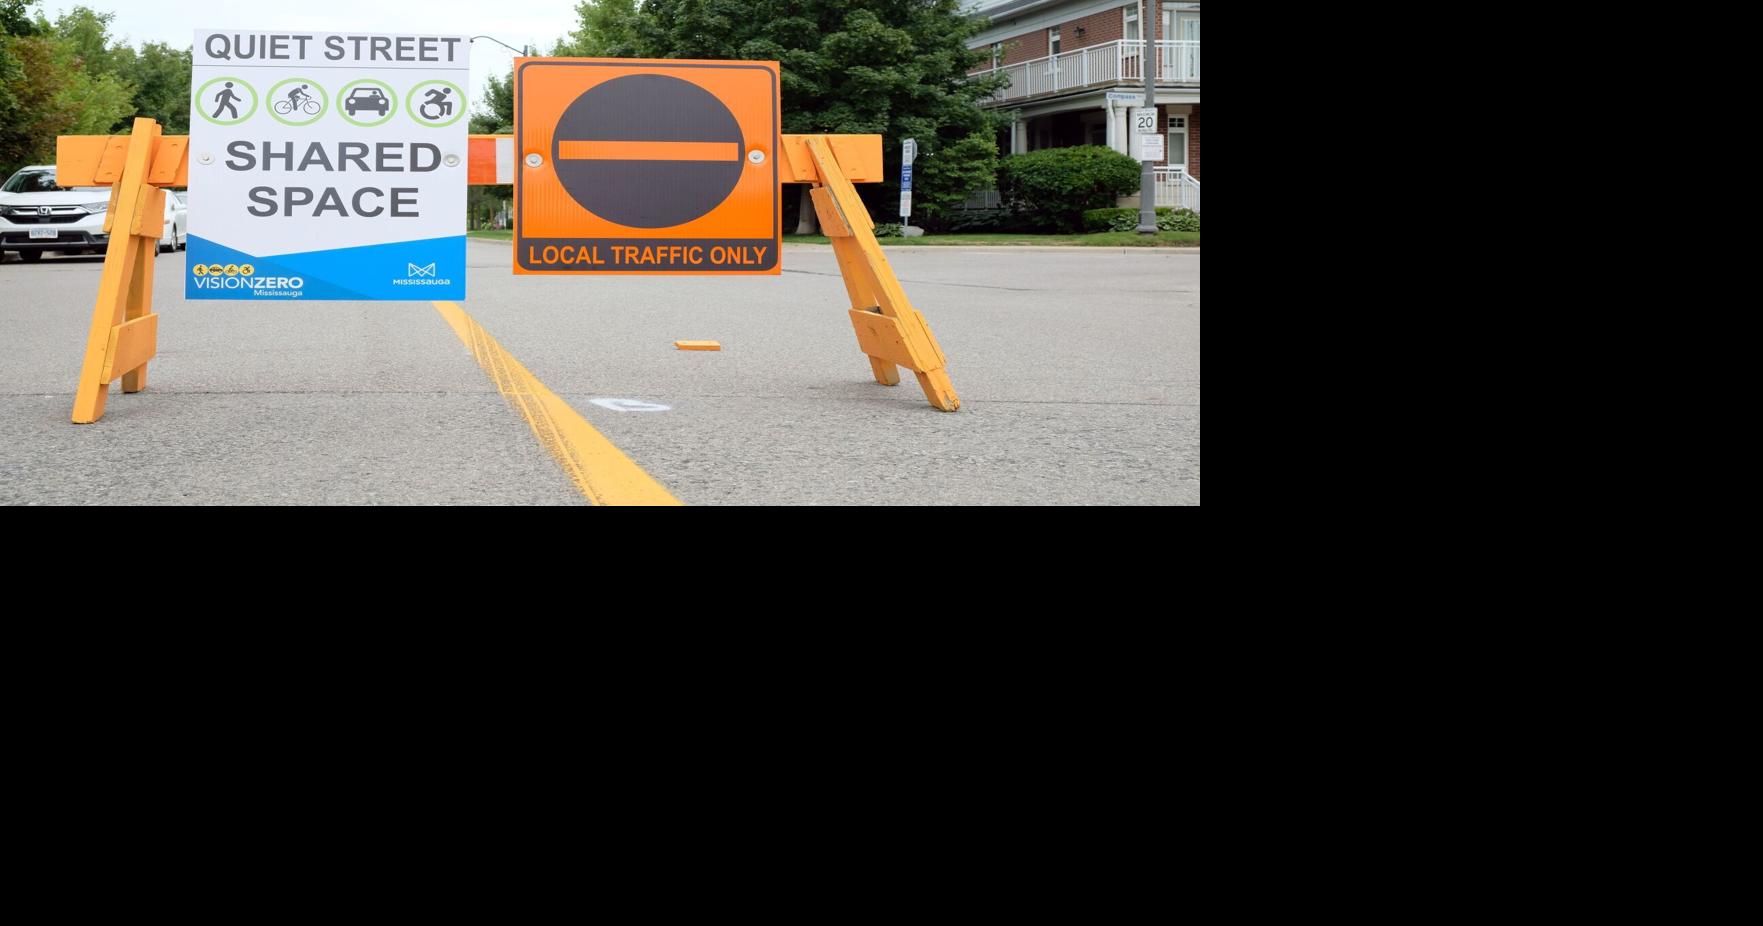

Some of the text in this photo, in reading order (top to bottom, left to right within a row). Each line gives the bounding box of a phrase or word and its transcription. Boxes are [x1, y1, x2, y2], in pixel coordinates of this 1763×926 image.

[205, 33, 461, 62] QUIET STREET
[1138, 116, 1153, 128] 20
[225, 140, 442, 173] SHARED
[246, 185, 420, 218] SPACE
[529, 245, 768, 265] LOCAL TRAFFIC ONLY
[193, 276, 304, 289] VISIONZERO
[253, 289, 303, 298] Mississauga
